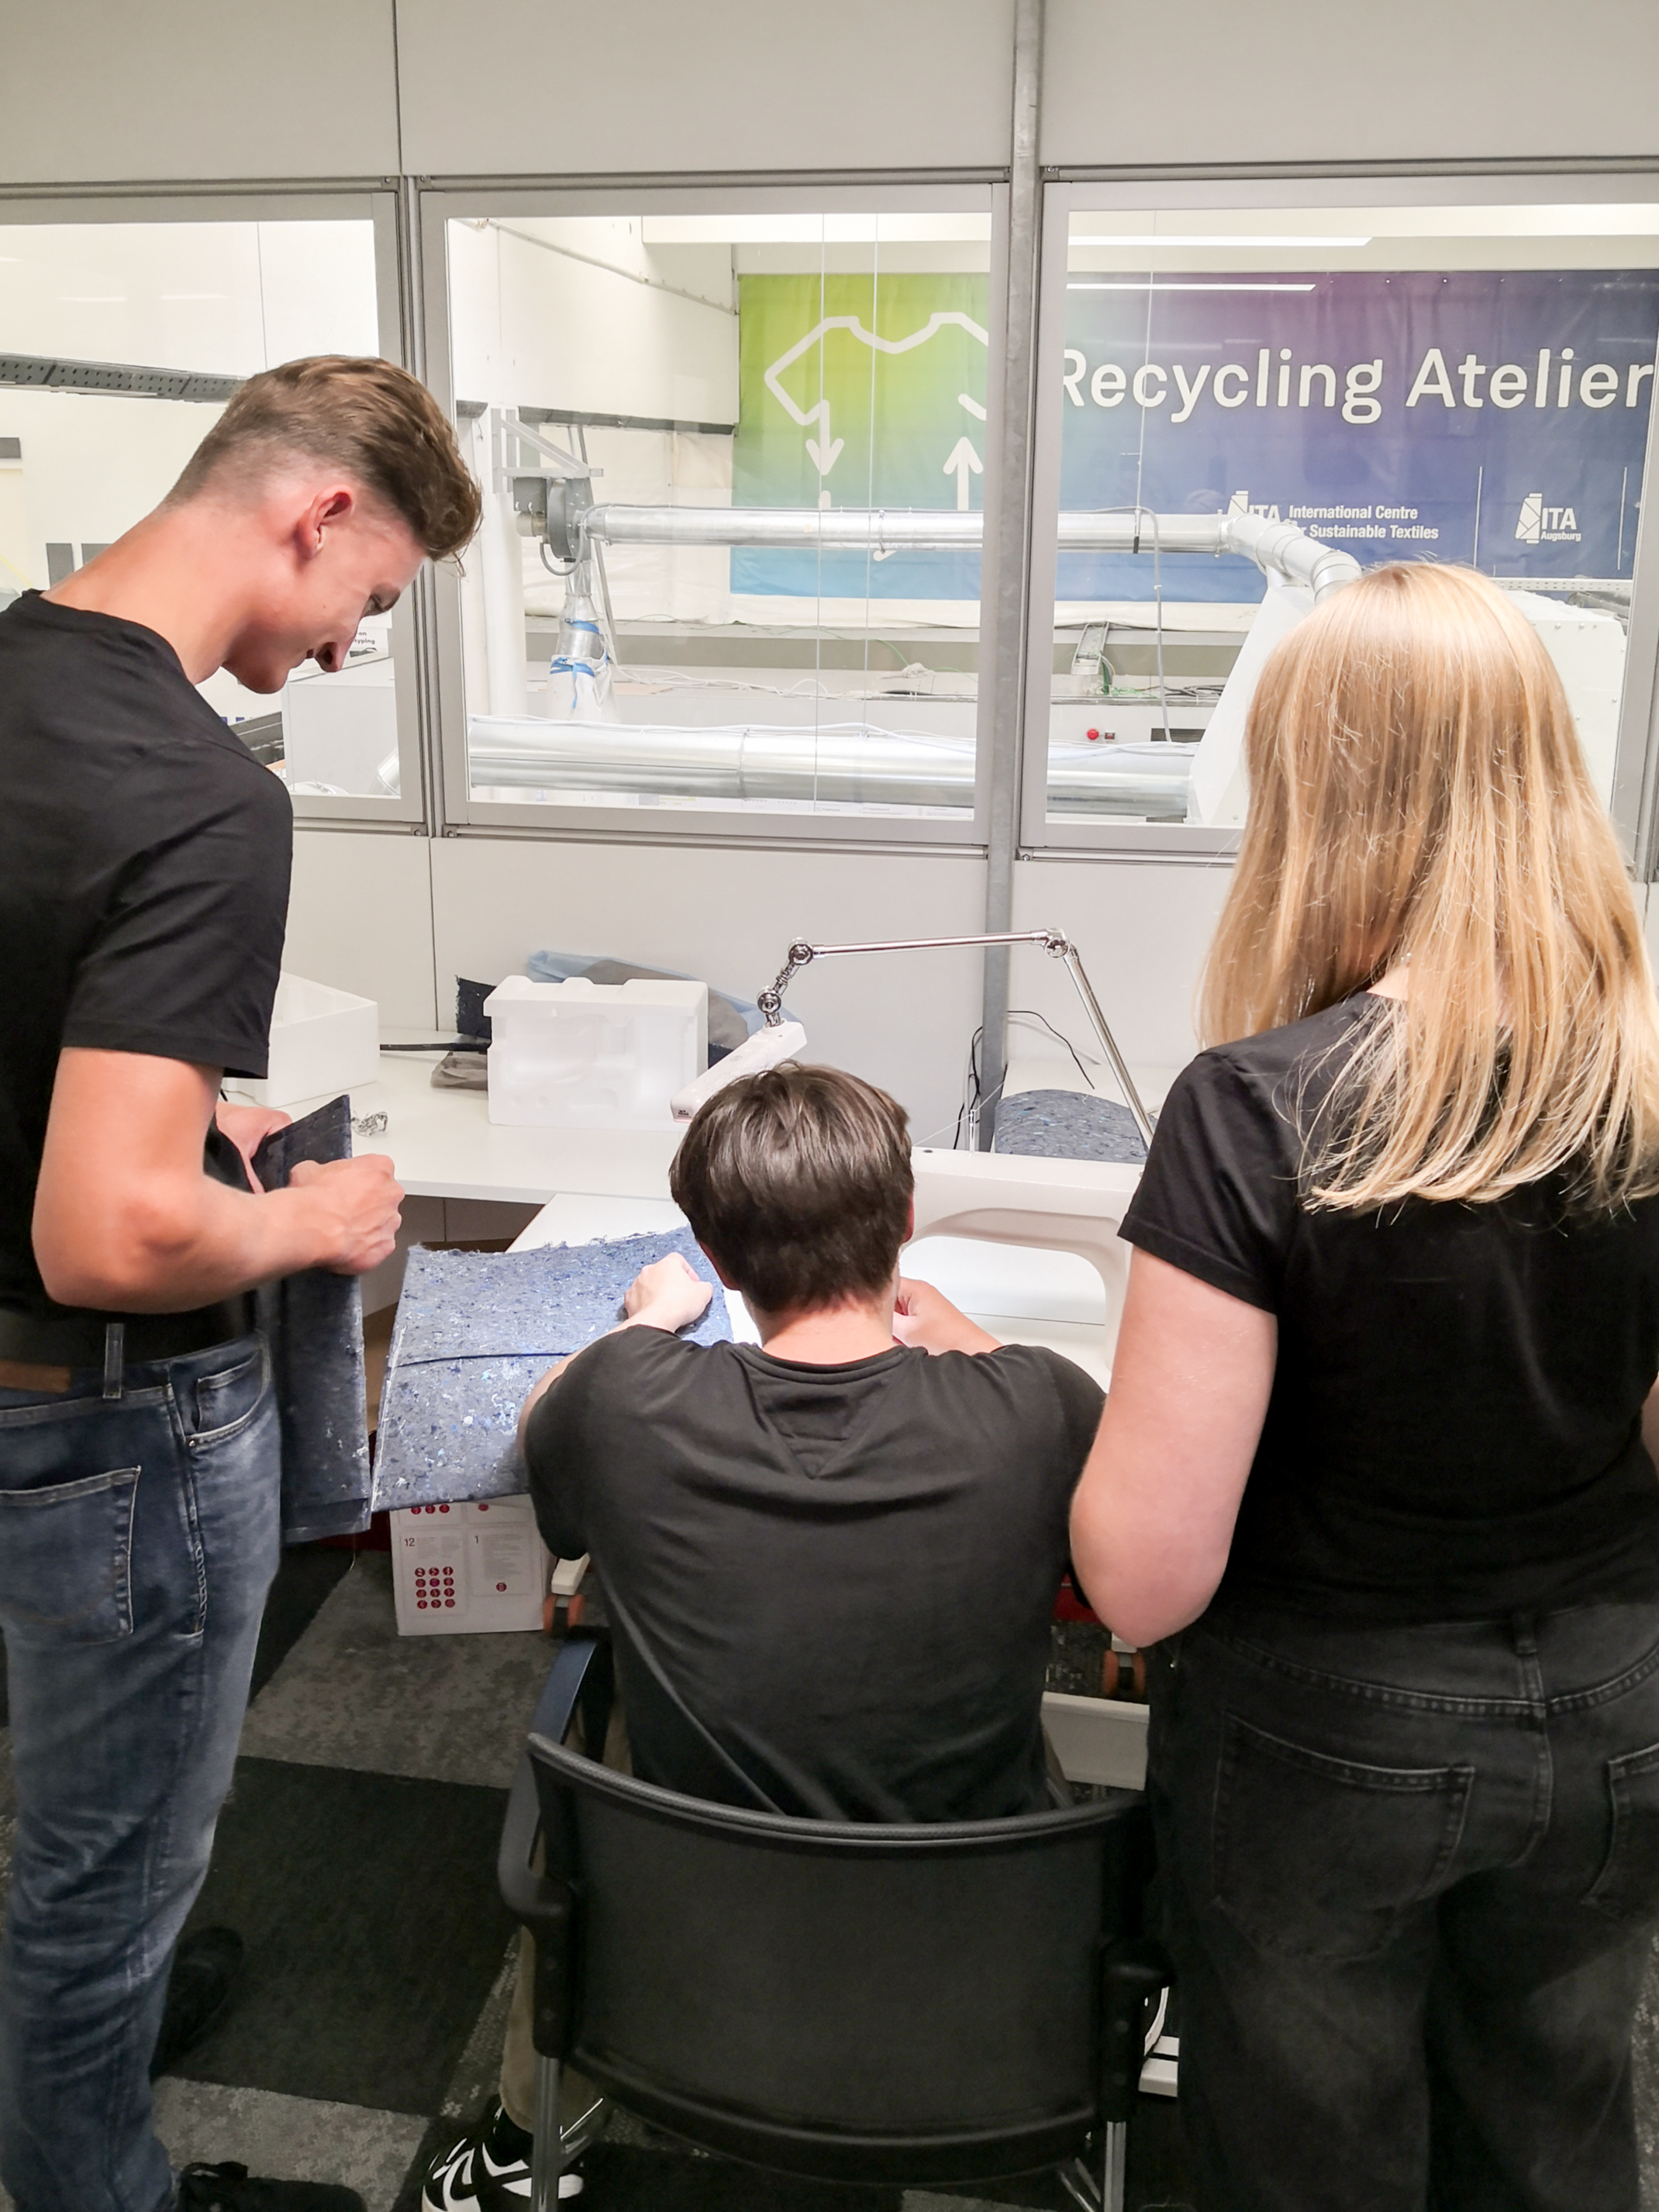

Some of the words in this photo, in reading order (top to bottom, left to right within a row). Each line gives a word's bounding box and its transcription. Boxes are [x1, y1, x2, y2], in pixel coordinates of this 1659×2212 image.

[1063, 347, 1383, 425] Recycling
[1405, 347, 1654, 409] Atelier
[1288, 504, 1372, 519] International
[1374, 505, 1419, 520] Centre
[1541, 507, 1578, 530] ITA
[1309, 523, 1387, 539] Sustainable
[1389, 524, 1440, 540] Textiles
[1540, 530, 1582, 542] Augsburg
[405, 1537, 416, 1547] 12
